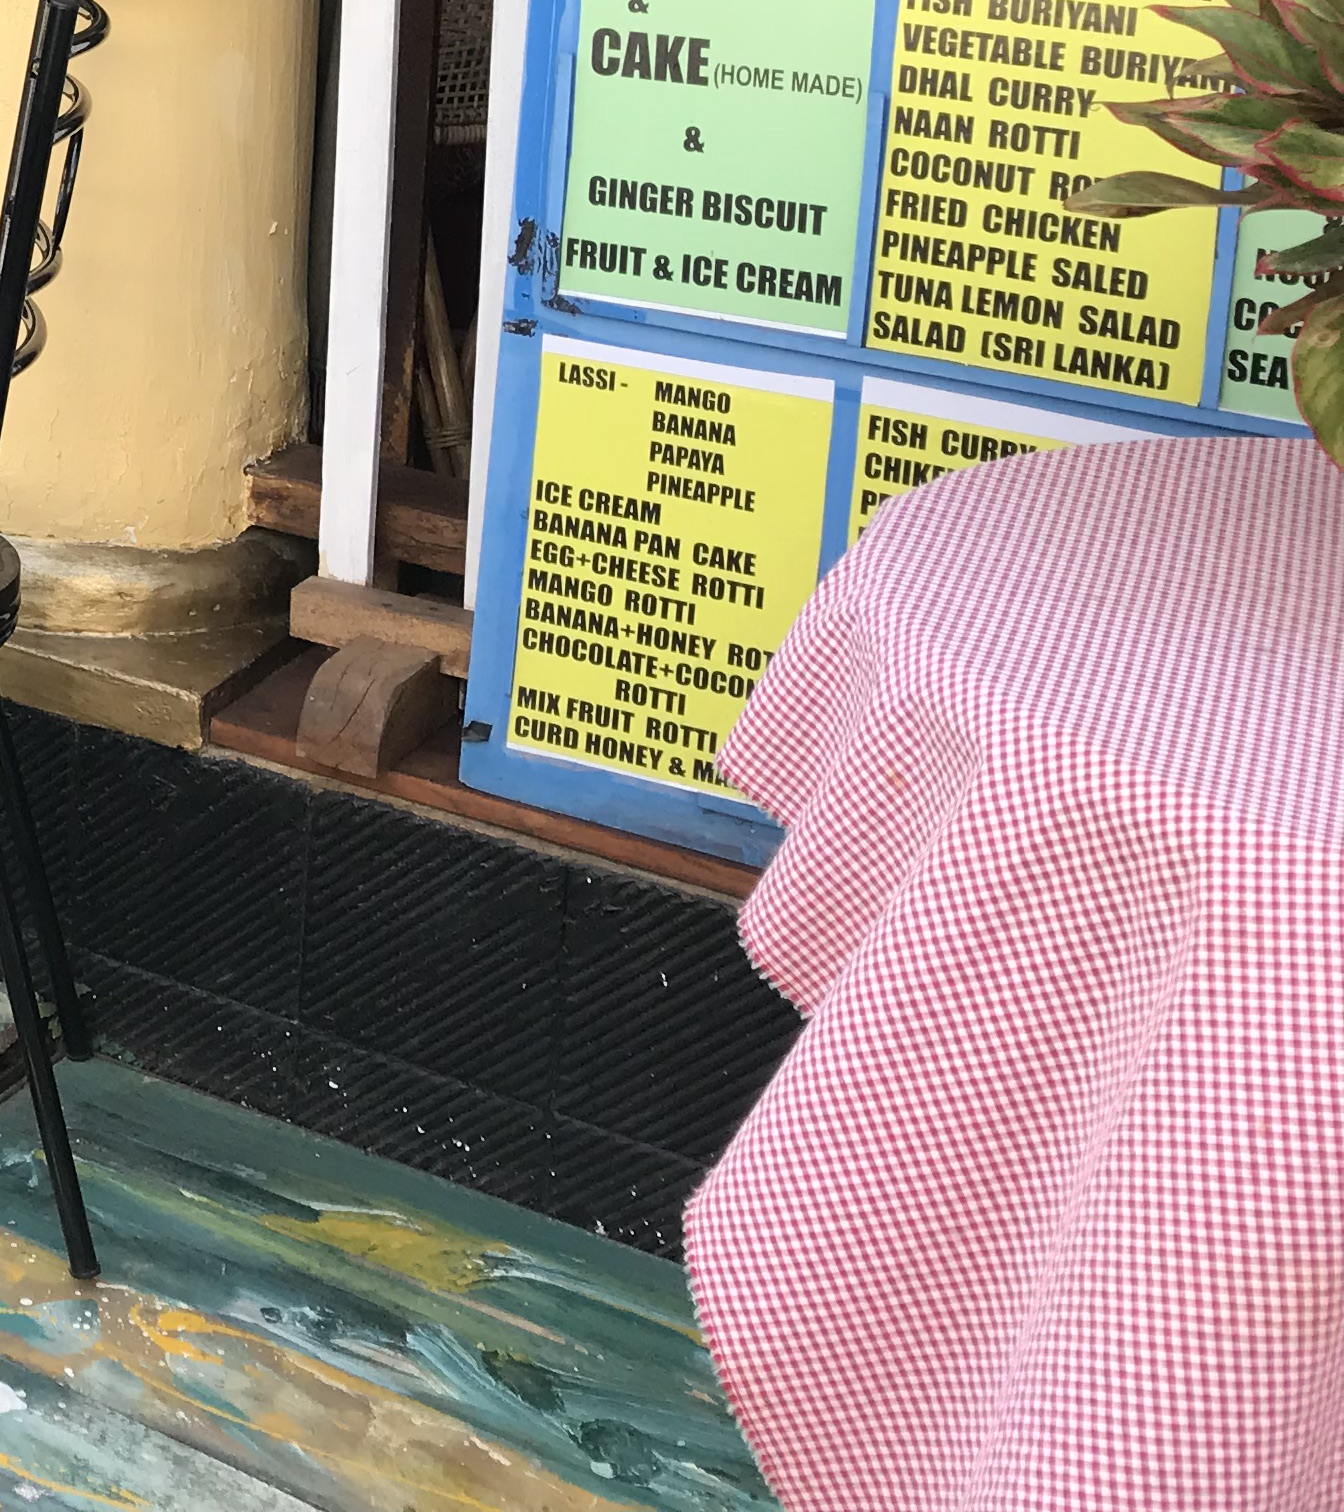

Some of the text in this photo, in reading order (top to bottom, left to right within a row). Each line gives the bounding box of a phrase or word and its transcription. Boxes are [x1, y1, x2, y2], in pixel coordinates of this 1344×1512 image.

[591, 28, 863, 104] CAKE (HOME MADE)
[903, 22, 1066, 72] VEGETABLE
[898, 63, 1096, 118] DHAL CURRY
[684, 126, 704, 153] &
[894, 106, 1081, 160] NAAN ROTTI
[890, 147, 1035, 195] COCONUT
[588, 175, 828, 236] GINGER BISCUIT
[886, 188, 1121, 253] FRIED CHICKEN
[566, 238, 843, 307] FRUIT & ICE CREAM
[881, 229, 1149, 301] PINEAPPLE SALED
[877, 270, 1181, 350] TUNA LEMON SALAD
[873, 310, 1170, 390] SALAD (SRI LANKA)
[654, 380, 732, 415] MANGO
[652, 411, 737, 446] BANANA
[868, 415, 928, 450] FISH
[649, 441, 726, 476] PAPAYA
[535, 479, 662, 526] ICE CREAM
[646, 471, 756, 513] PINEAPPLE
[533, 510, 757, 577] BANANA PAN CAKE
[527, 569, 697, 626] MANGO ROTTI
[530, 539, 766, 610] EGG+CHEESE ROTTI
[525, 598, 717, 661] BANANA+HONEY
[517, 685, 718, 754] MIX FRUIT ROTTI
[614, 679, 687, 716] ROTTI
[514, 715, 687, 777] CURD HONEY &
